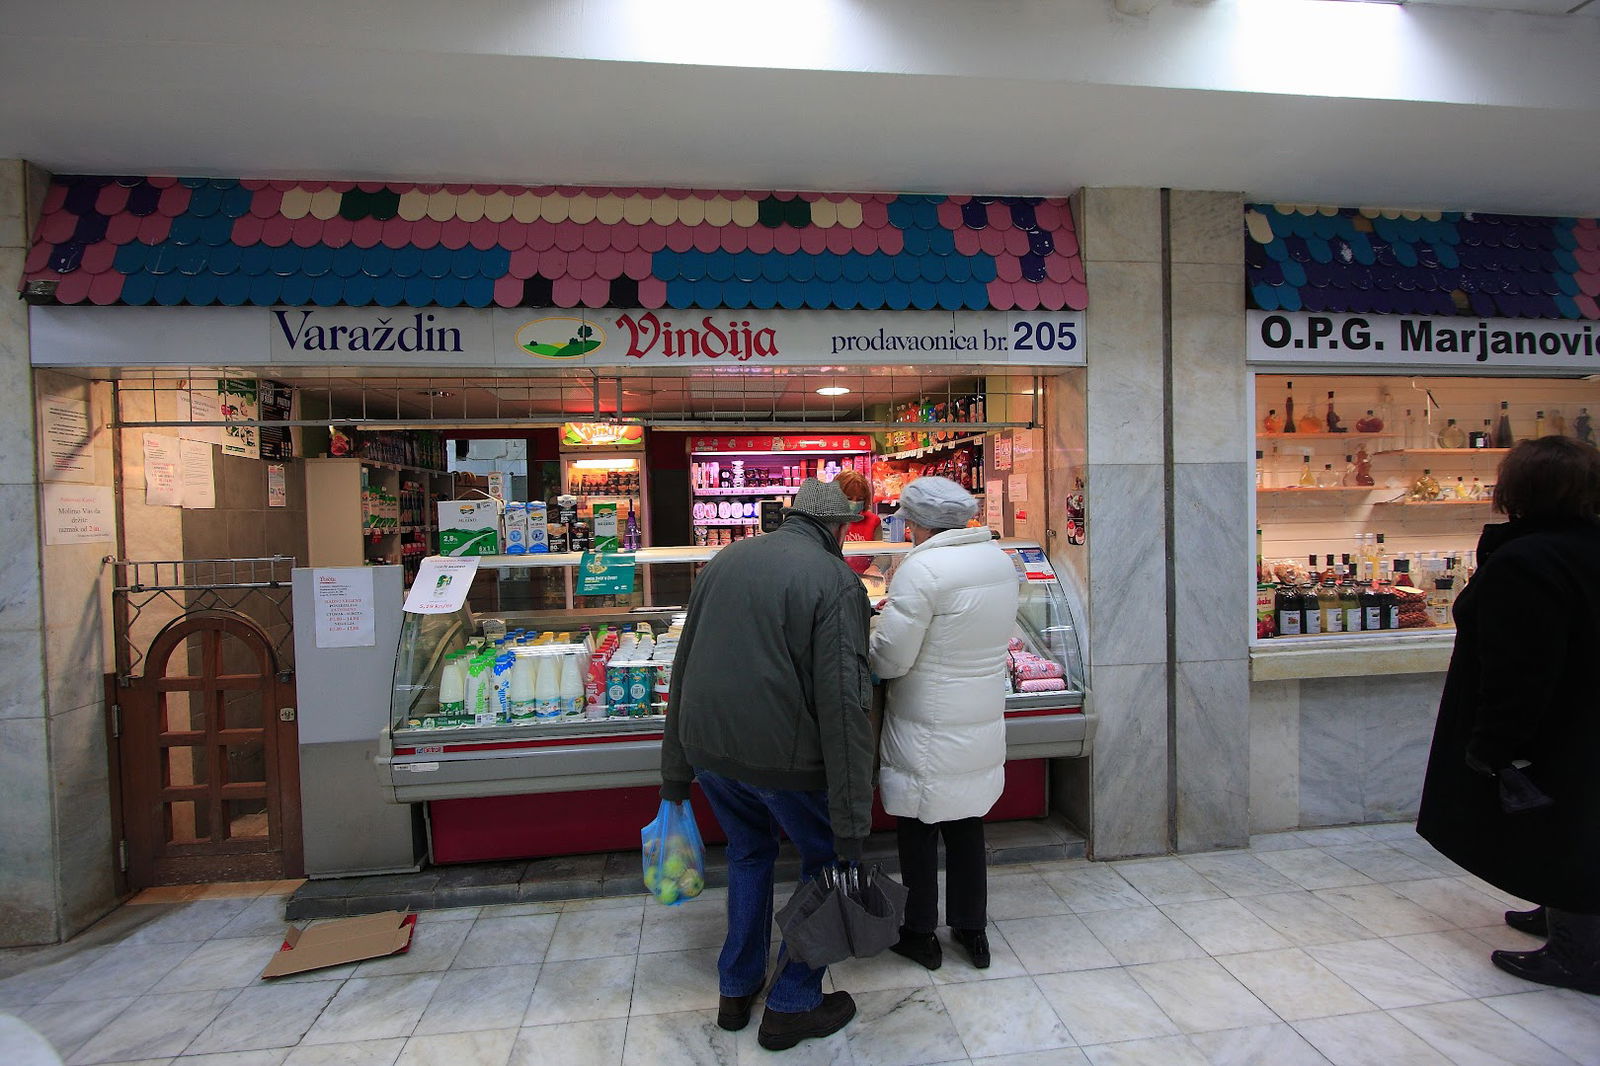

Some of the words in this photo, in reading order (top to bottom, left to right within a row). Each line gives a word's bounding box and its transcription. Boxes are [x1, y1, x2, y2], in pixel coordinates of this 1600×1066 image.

[272, 310, 464, 352] Varaždin
[615, 311, 779, 361] Vindija
[831, 328, 977, 354] prodavaonica
[983, 329, 1008, 351] br.
[1013, 321, 1077, 351] 205
[1261, 315, 1384, 350] O.P.G.
